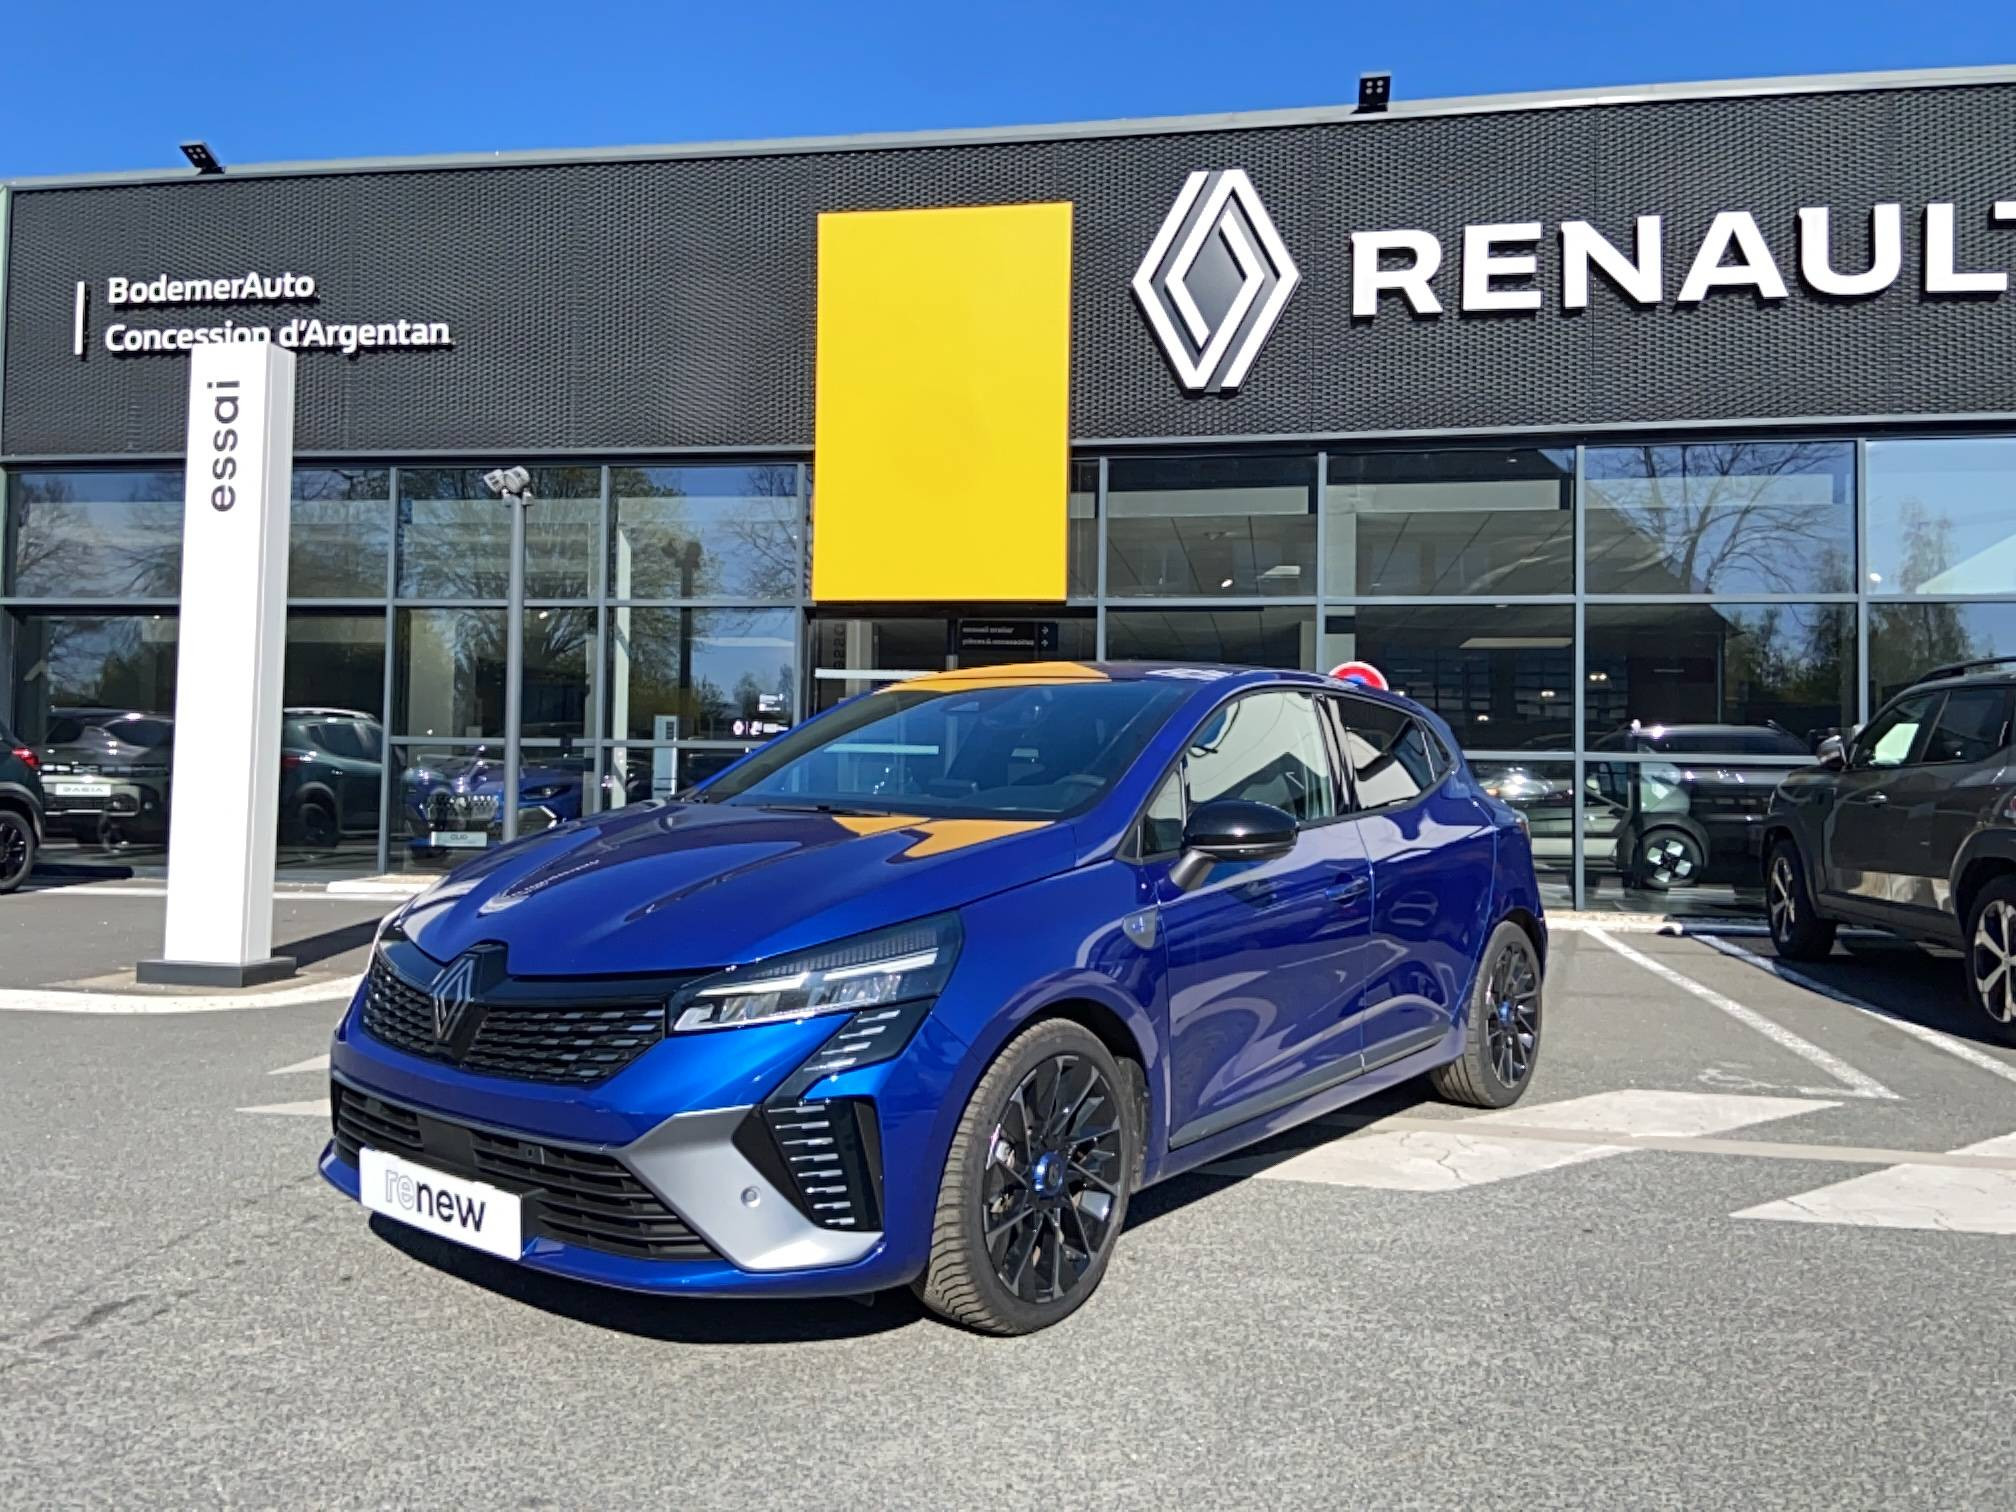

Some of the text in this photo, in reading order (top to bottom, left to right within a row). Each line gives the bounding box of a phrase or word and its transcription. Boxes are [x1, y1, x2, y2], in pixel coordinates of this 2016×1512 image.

[108, 272, 316, 303] BodemerAuto
[1351, 201, 2016, 315] RENAUL
[105, 318, 451, 353] Concession d'Argentan
[207, 381, 240, 512] essai
[385, 1169, 487, 1232] renew
